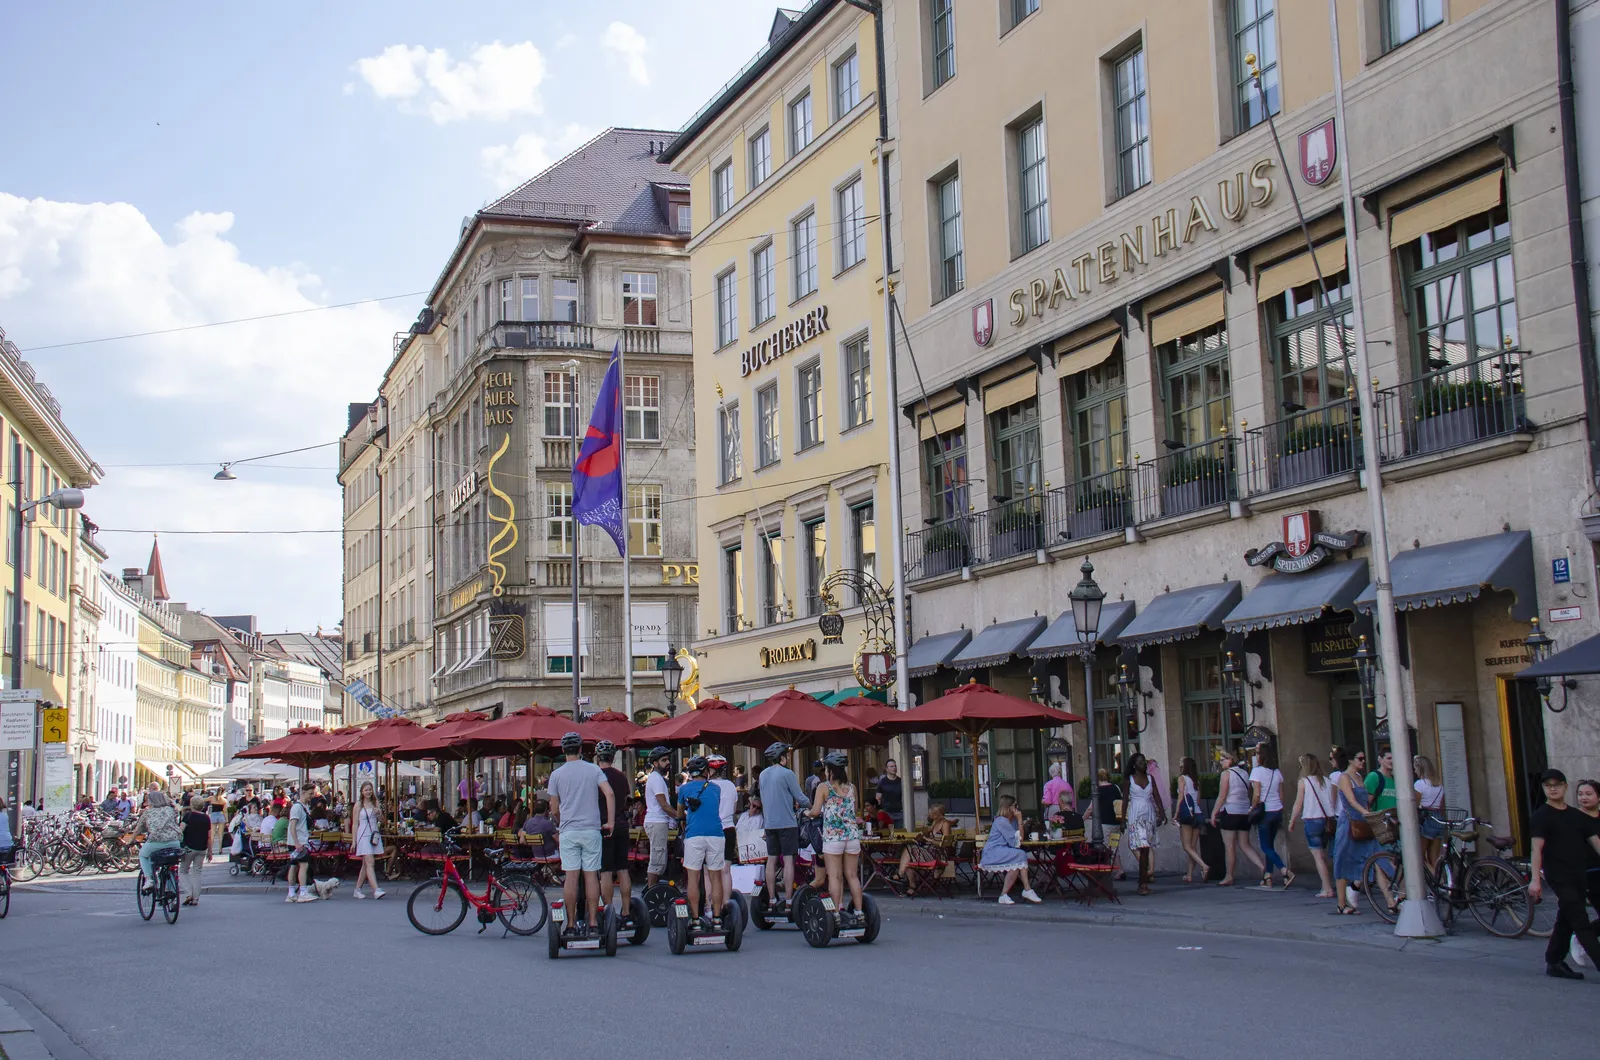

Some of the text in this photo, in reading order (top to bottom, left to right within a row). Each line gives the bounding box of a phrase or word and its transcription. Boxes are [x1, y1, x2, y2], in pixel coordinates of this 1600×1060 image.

[1322, 162, 1329, 172] S
[1009, 158, 1278, 327] SPATENHAUS
[741, 304, 830, 378] BUCHERER
[1288, 542, 1307, 552] G S
[1277, 552, 1319, 571] SPATENHAUS
[1555, 559, 1566, 571] 12
[769, 643, 803, 664] ROLEX
[1485, 656, 1519, 666] SEUFERT
